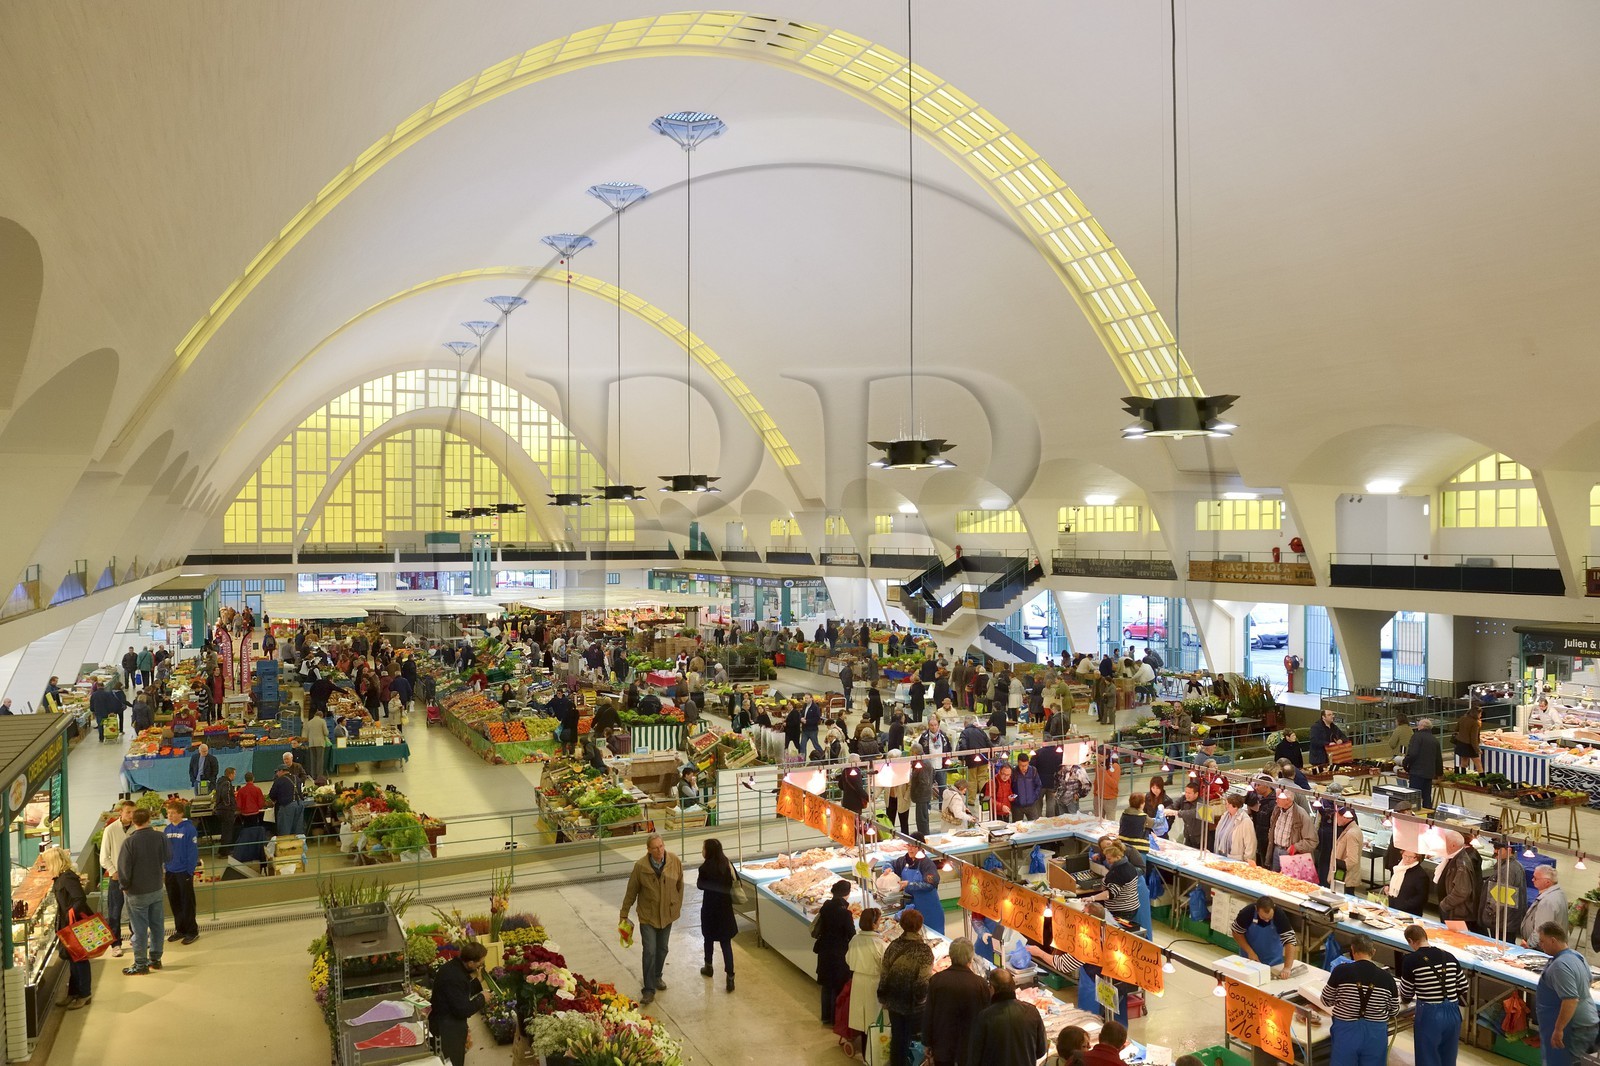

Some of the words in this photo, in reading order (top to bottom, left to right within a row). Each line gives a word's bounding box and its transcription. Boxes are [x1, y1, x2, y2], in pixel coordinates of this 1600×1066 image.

[1563, 638, 1588, 649] Julien
[1590, 640, 1597, 649] &
[1106, 930, 1160, 966] Cabillaud
[1230, 1019, 1254, 1039] 16
